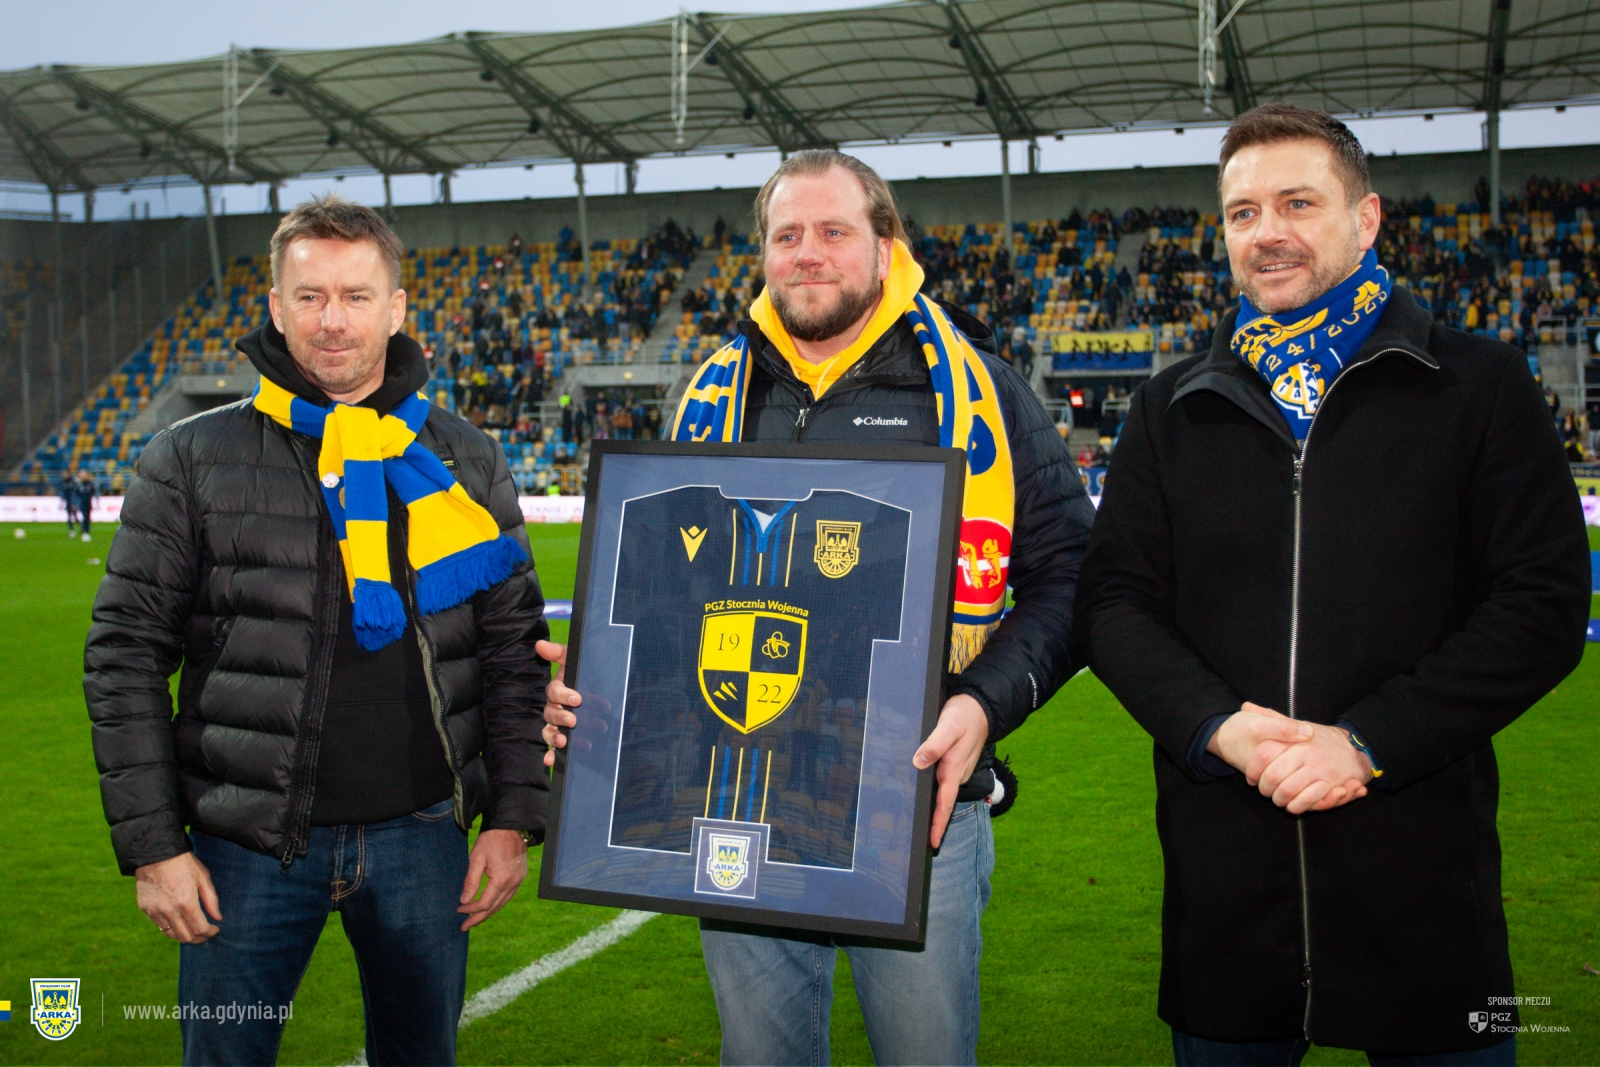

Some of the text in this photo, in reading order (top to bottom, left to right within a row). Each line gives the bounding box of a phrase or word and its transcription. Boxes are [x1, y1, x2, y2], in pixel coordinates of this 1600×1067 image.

[863, 416, 908, 426] Columbia
[822, 551, 851, 560] ARKA
[704, 599, 809, 617] PGZ Stocznia Wojenna
[718, 632, 740, 652] 19
[756, 683, 782, 704] 22
[714, 863, 741, 872] ARKA
